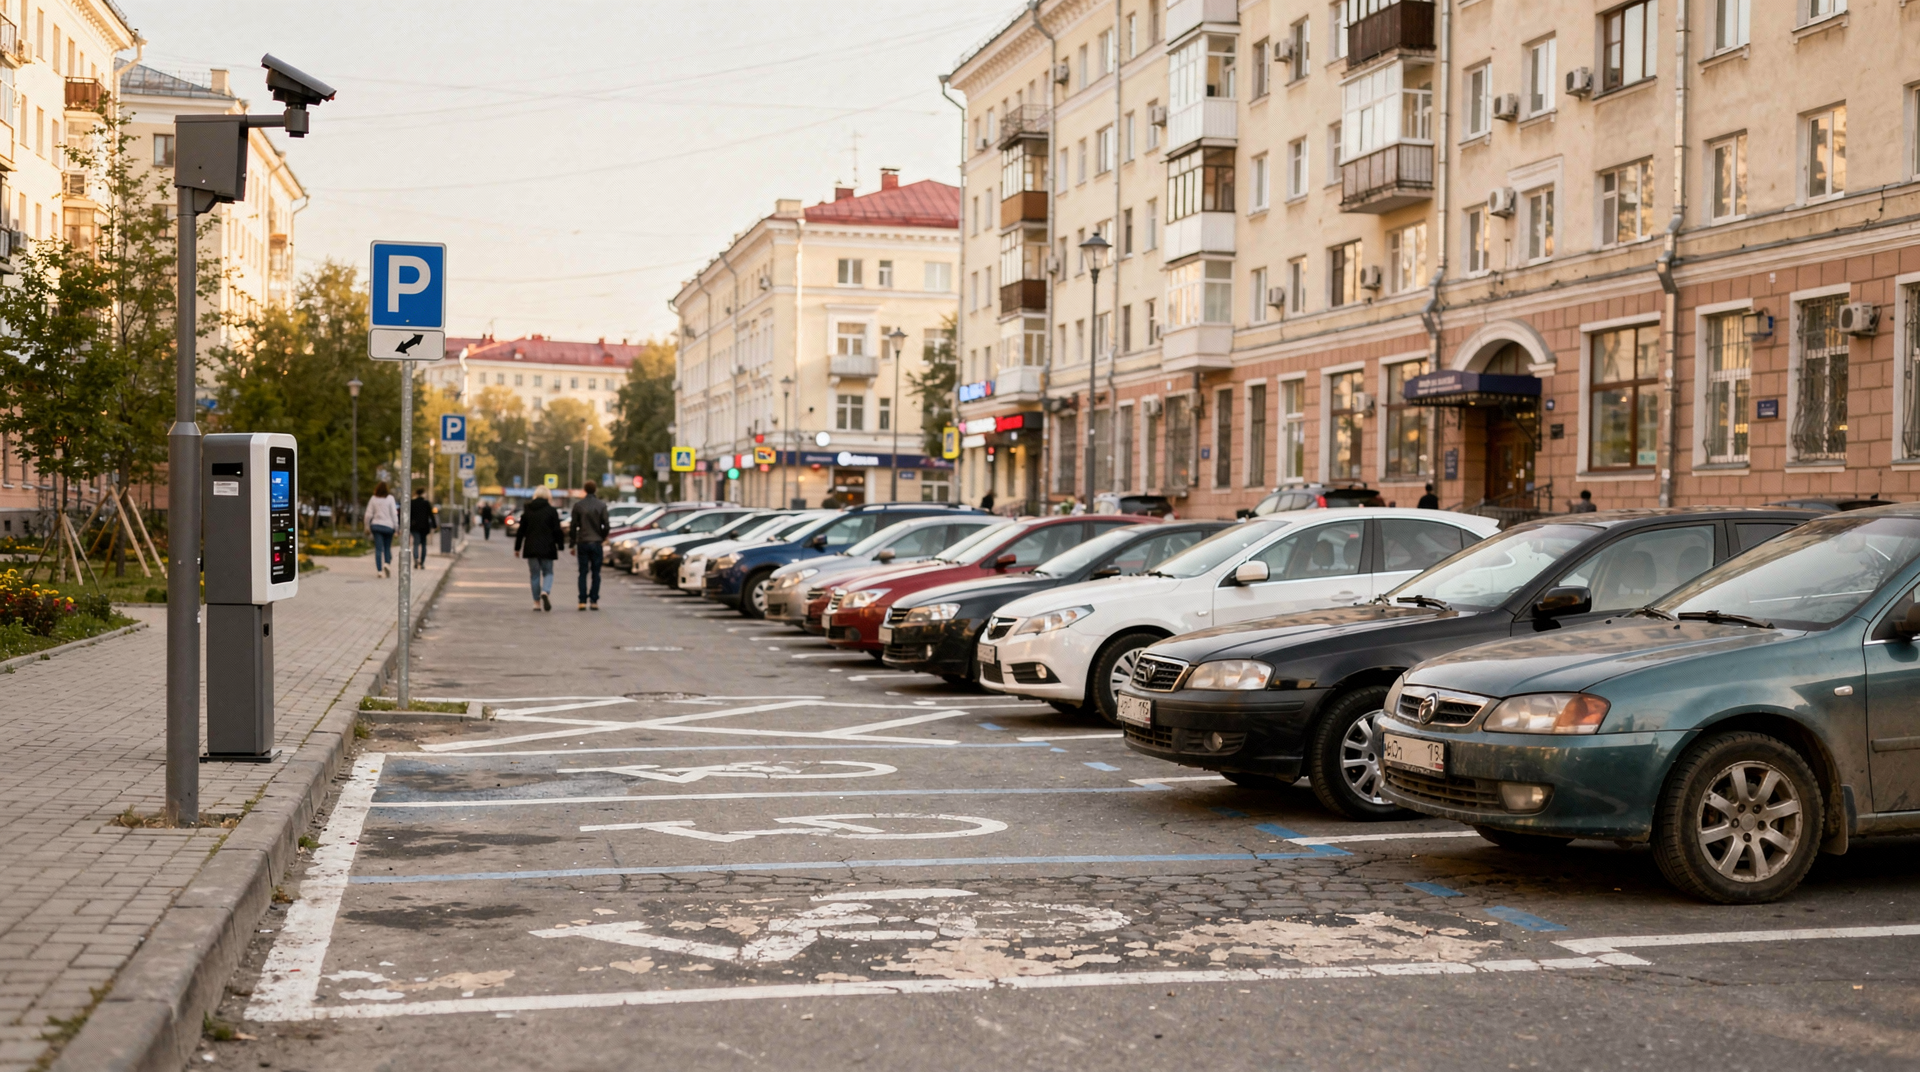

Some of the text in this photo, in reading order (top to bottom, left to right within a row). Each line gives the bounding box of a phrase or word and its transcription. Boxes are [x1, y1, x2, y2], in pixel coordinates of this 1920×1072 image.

[387, 255, 431, 313] P
[446, 417, 462, 439] P
[462, 455, 473, 469] P
